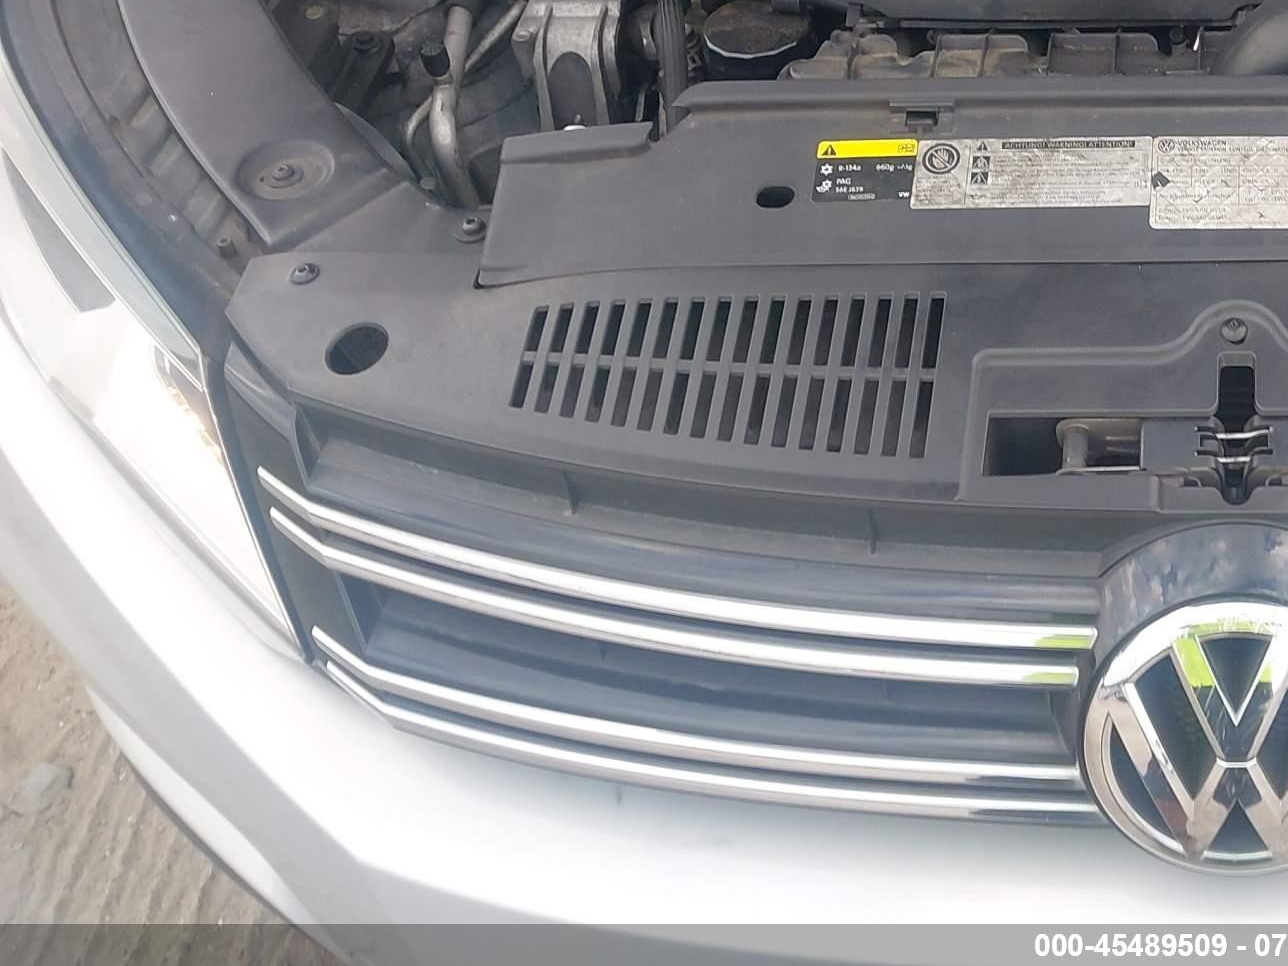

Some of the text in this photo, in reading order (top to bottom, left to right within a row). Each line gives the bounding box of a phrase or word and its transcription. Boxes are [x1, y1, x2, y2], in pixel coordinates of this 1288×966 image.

[1177, 139, 1227, 147] VOLKSWAGEN
[838, 163, 862, 172] R-134a
[875, 163, 895, 172] 660g
